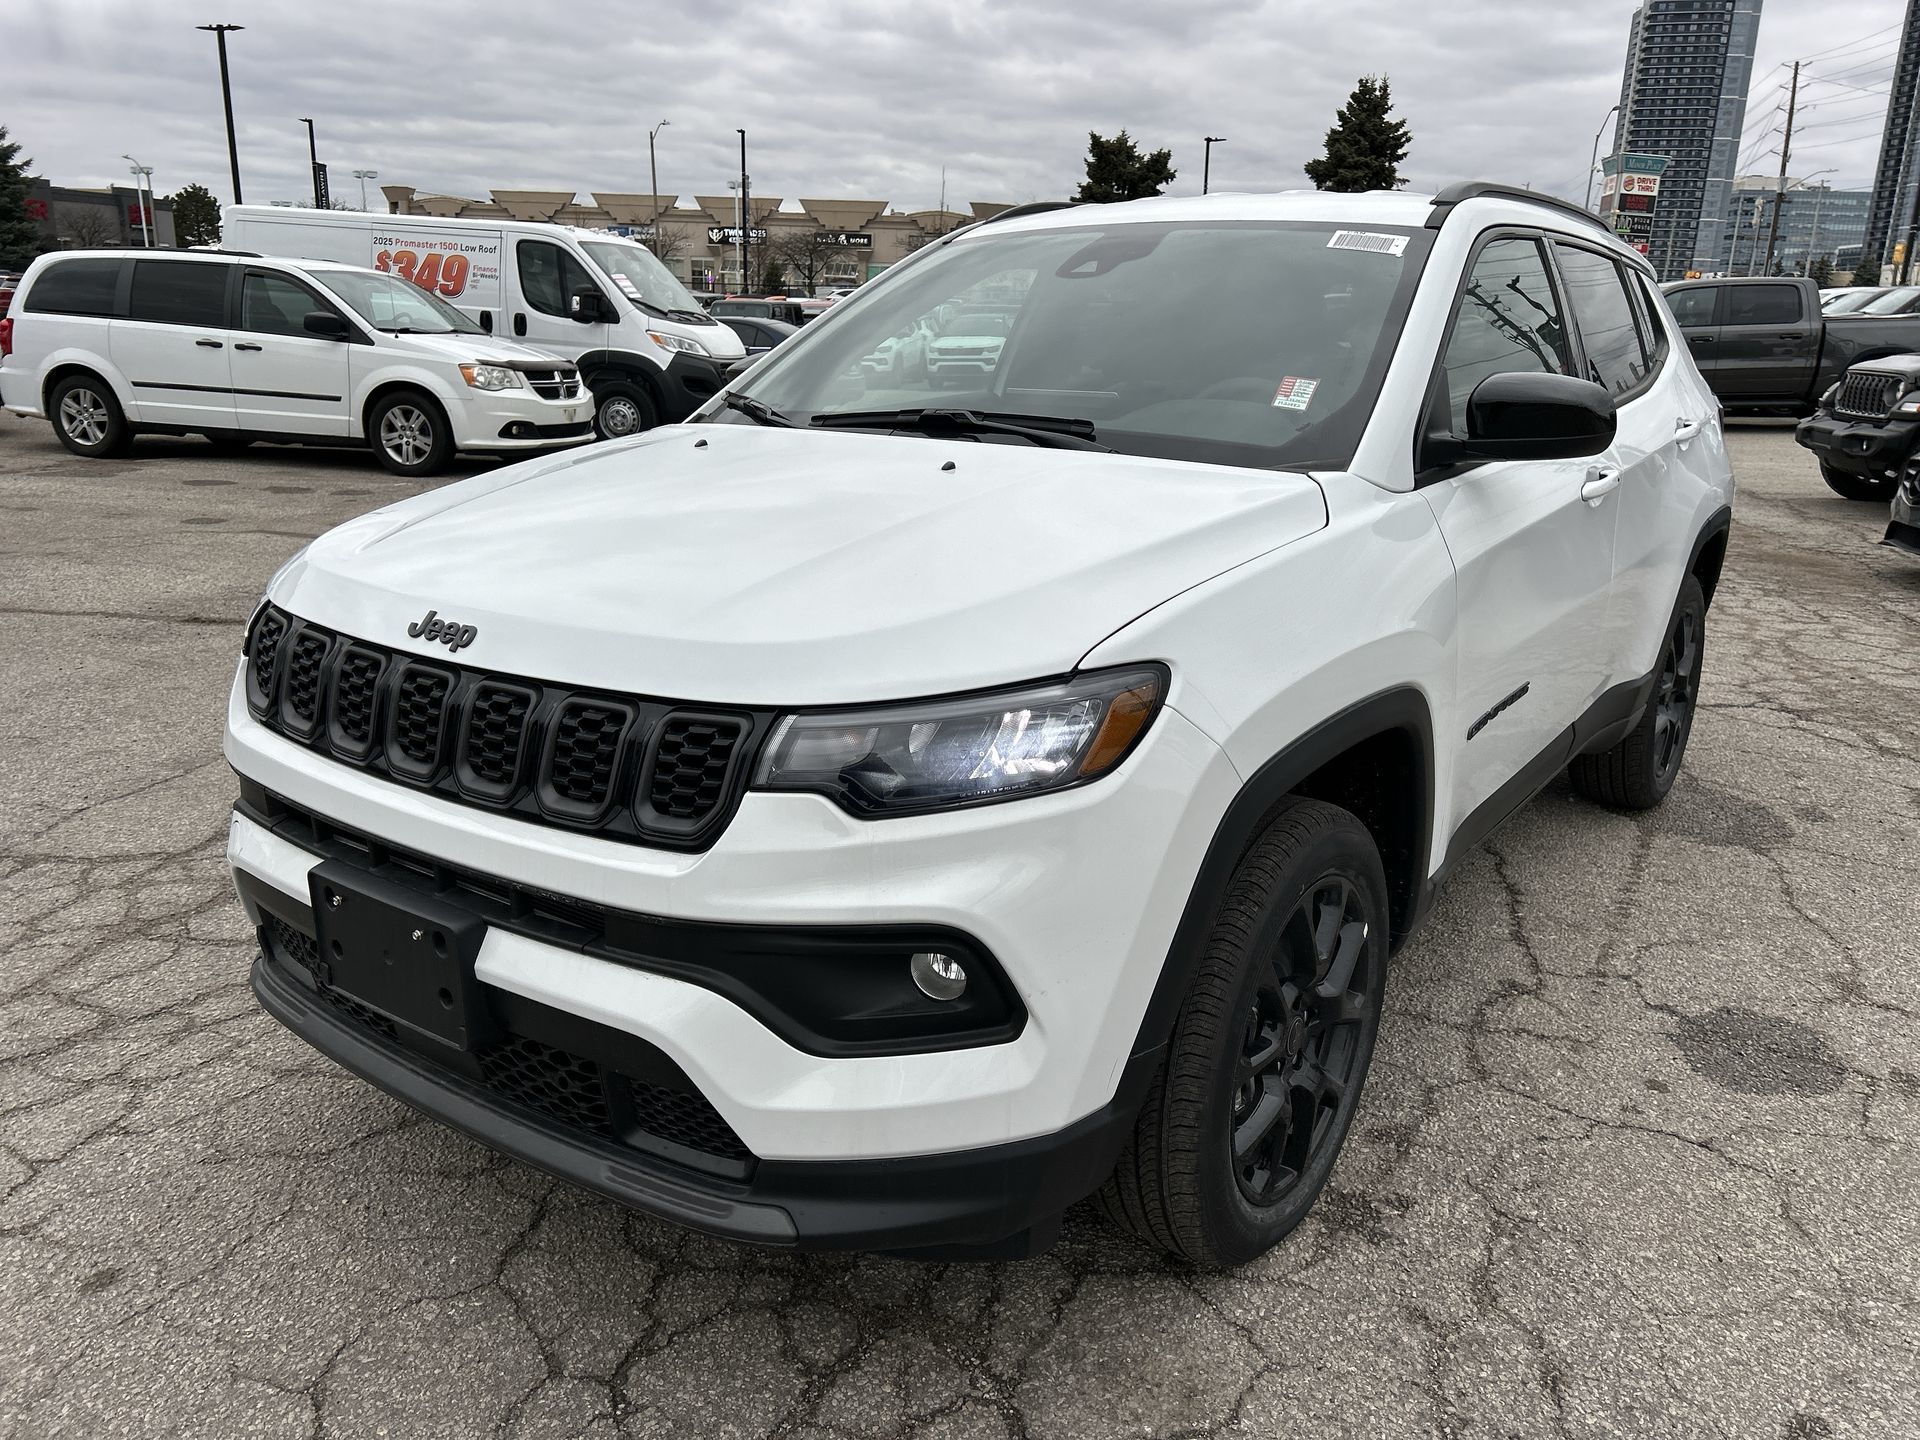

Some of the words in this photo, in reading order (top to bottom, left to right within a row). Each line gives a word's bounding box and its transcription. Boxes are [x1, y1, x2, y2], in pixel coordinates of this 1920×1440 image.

[1637, 177, 1657, 186] DRIVE
[723, 228, 744, 237] TWIN
[373, 236, 393, 246] 2025
[394, 238, 438, 250] Promaster
[439, 241, 459, 251] 1500
[460, 243, 477, 253] Low
[478, 244, 498, 254] Roof
[472, 264, 498, 273] Finance
[374, 249, 471, 299] $349
[472, 272, 499, 281] Bi-Weekly
[407, 609, 478, 653] Jeep
